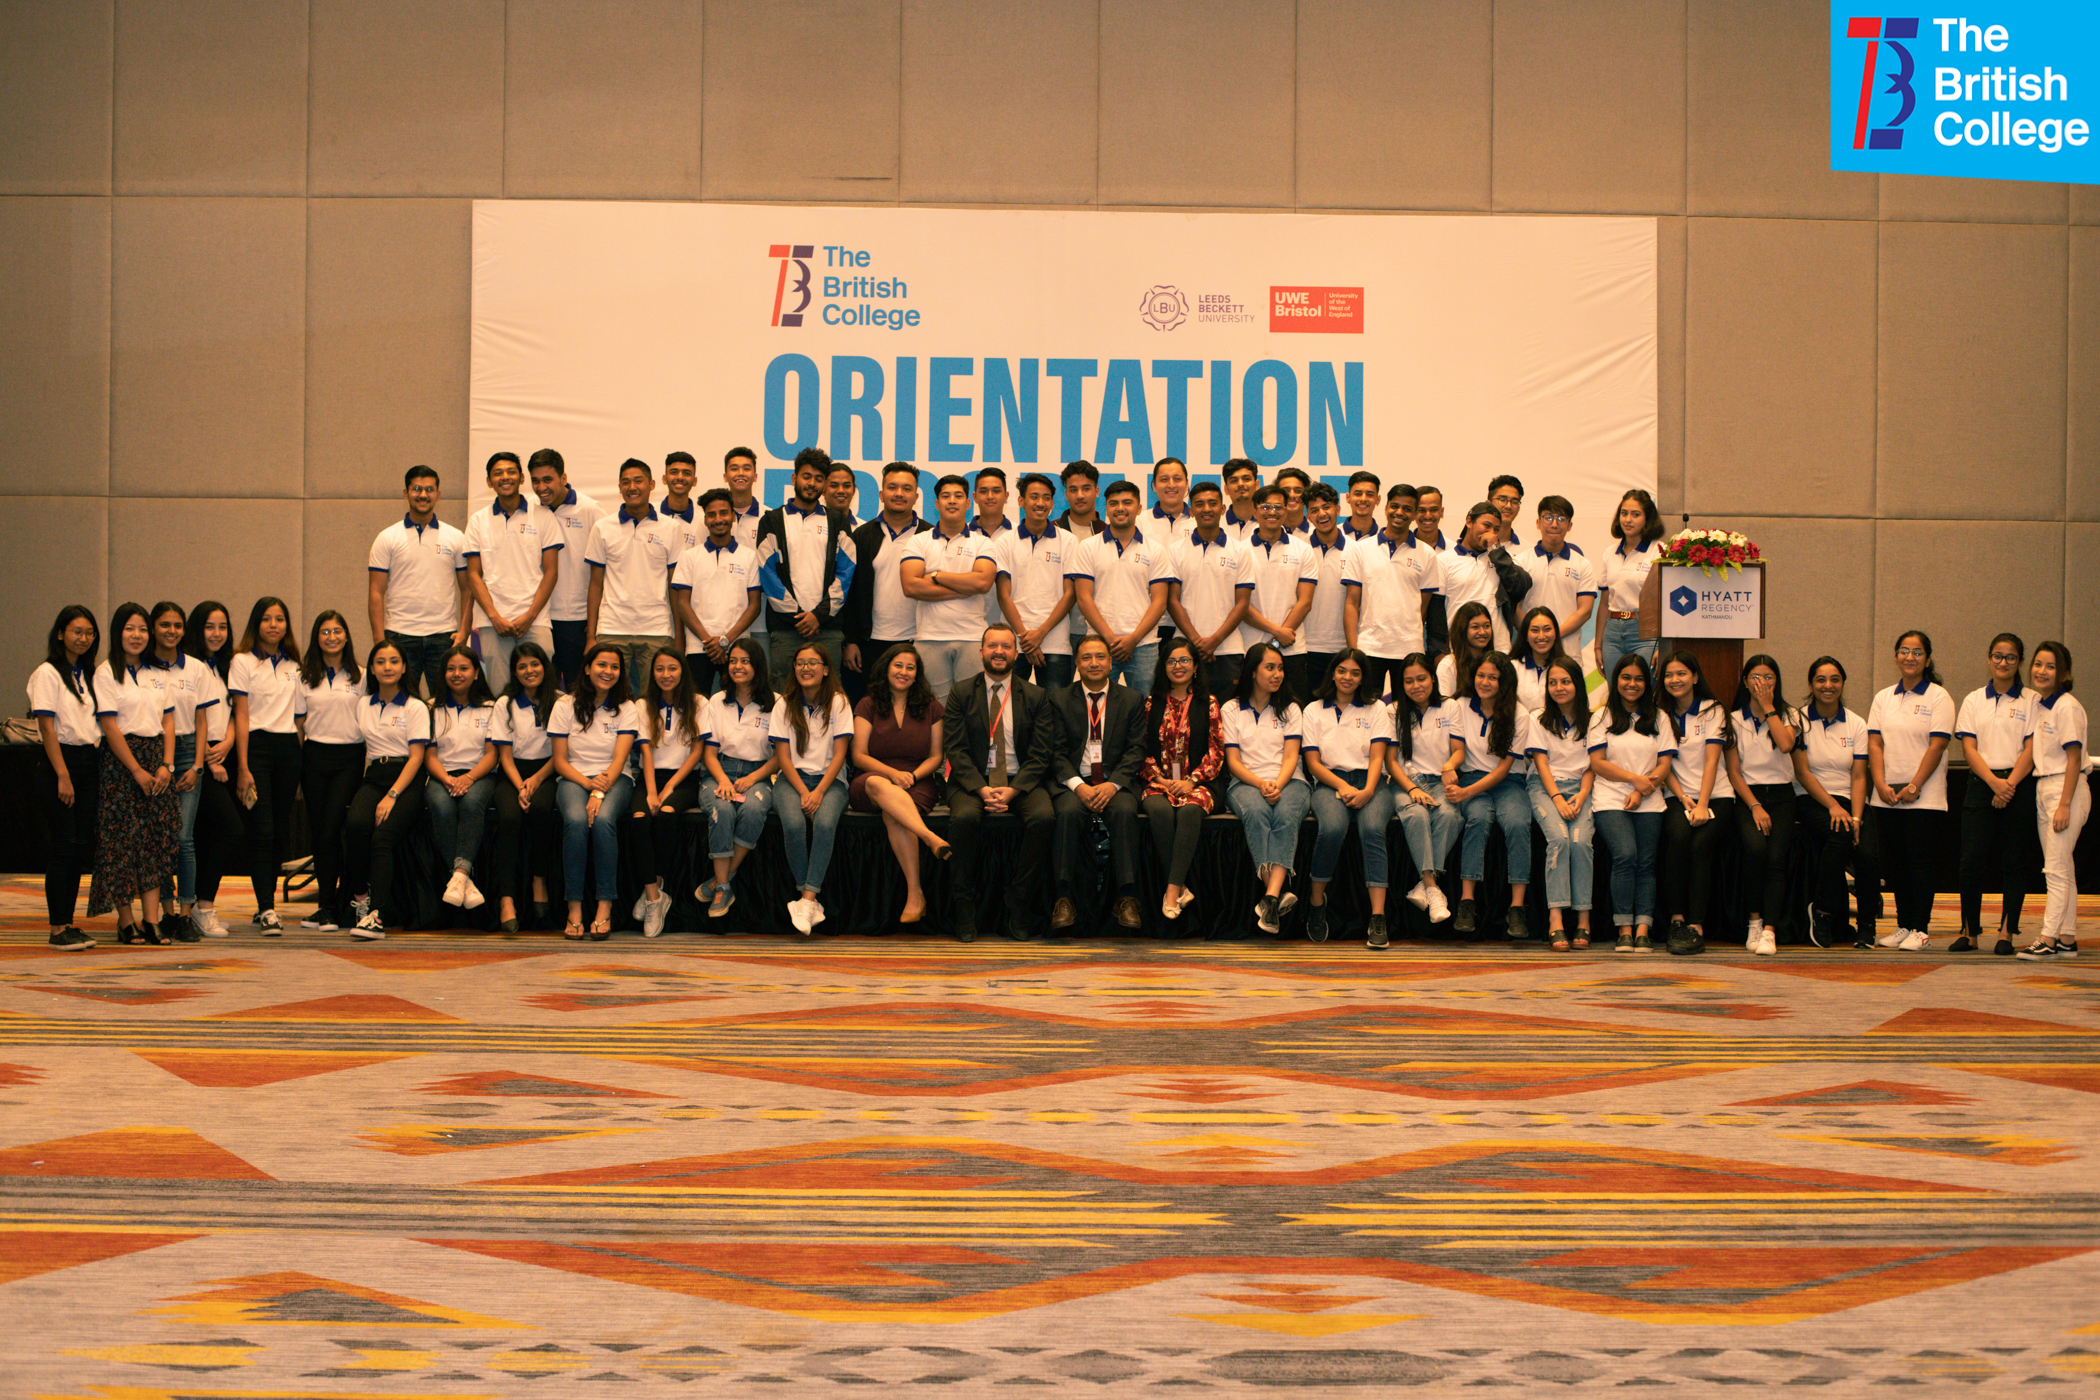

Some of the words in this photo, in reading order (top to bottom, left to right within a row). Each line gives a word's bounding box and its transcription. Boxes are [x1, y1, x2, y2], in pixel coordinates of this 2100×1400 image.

[823, 245, 871, 268] The
[823, 276, 908, 299] British
[1198, 294, 1231, 304] LEEDS
[1275, 291, 1310, 304] UWE
[1198, 304, 1245, 313] BECKETT
[1275, 304, 1322, 317] Bristol
[822, 303, 921, 331] College
[1198, 314, 1256, 323] UNIVERSITY
[1328, 311, 1353, 319] England
[763, 352, 1365, 467] ORIENTATION
[1701, 590, 1753, 602] HYATT
[1701, 604, 1752, 612] REGENCY
